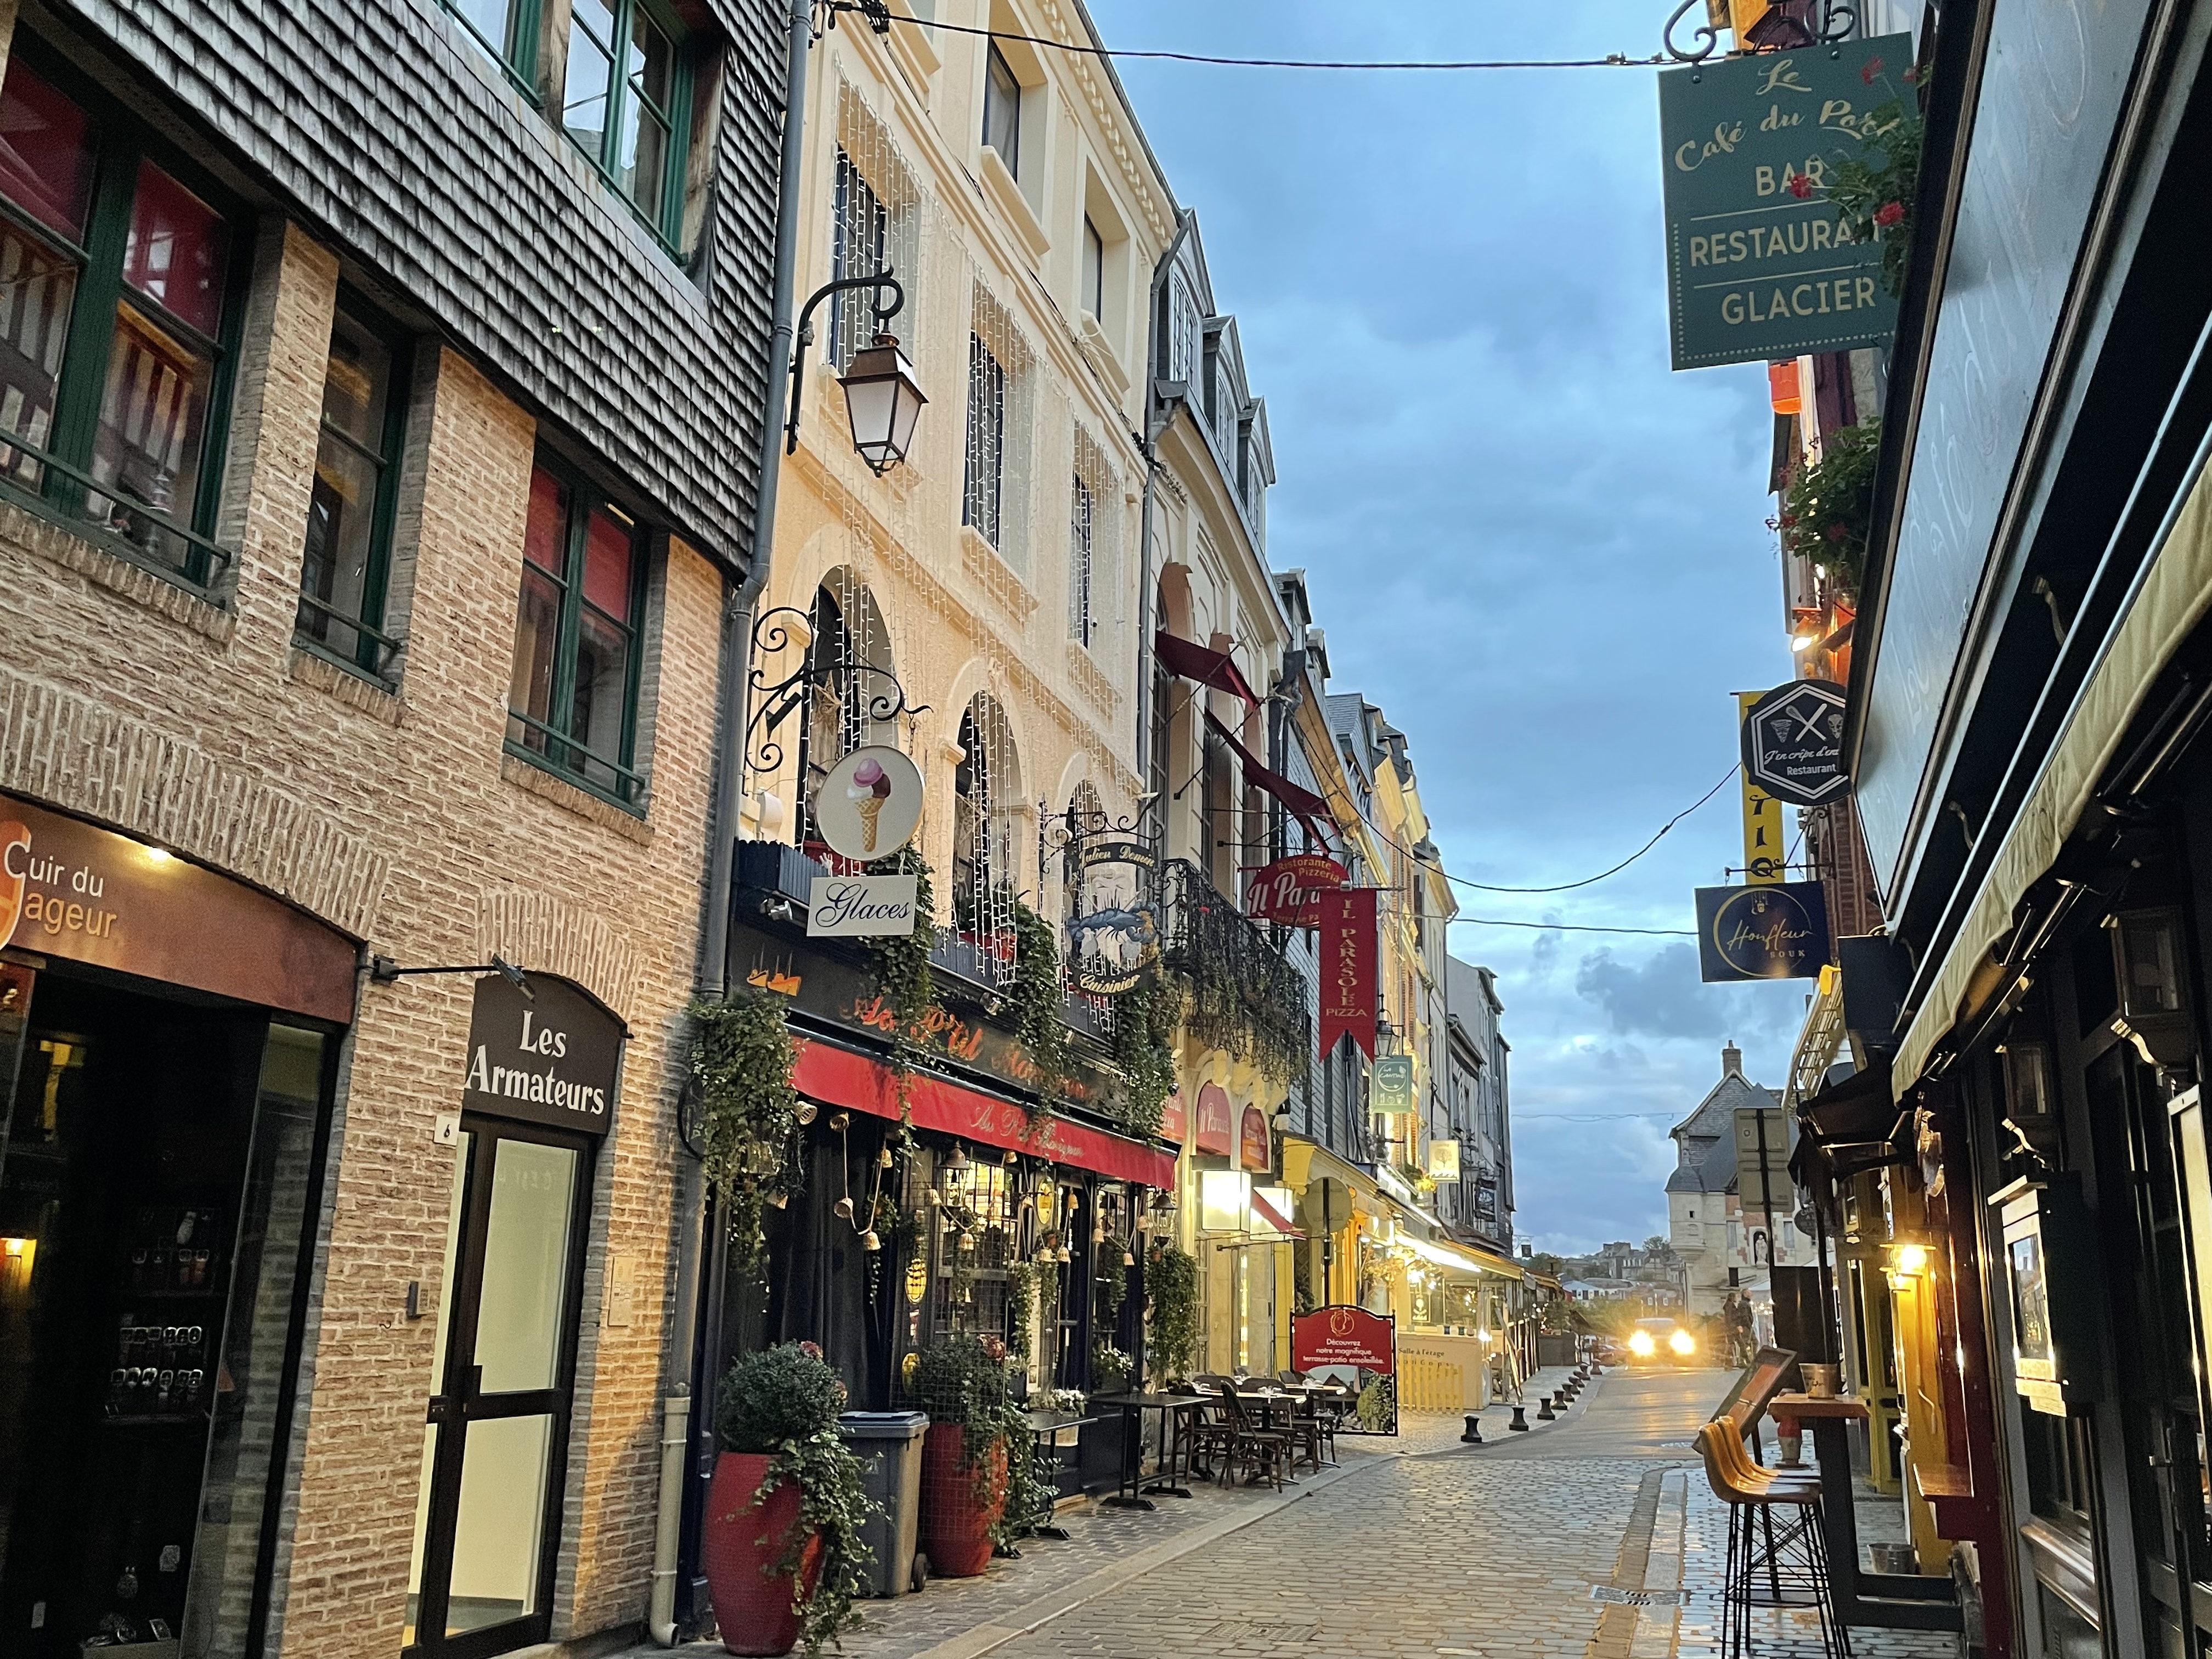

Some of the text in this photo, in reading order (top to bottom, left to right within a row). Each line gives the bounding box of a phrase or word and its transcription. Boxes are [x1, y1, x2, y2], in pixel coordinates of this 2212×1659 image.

[1756, 59, 1812, 95] Le
[1675, 121, 1747, 172] Café
[1760, 105, 1806, 132] du
[1755, 159, 1825, 196] BAR
[1721, 276, 1877, 325] GLACIER
[1786, 763, 1837, 776] Restaurant
[4, 840, 104, 898] Cuir du
[1277, 859, 1331, 872] Ristorante
[1299, 868, 1340, 883] Pizzeria
[815, 883, 911, 928] Glaces
[1249, 883, 1269, 913] Il
[1727, 918, 1814, 951] Honfleur
[1338, 928, 1358, 1006] PARASOLE
[1770, 950, 1805, 958] SOUK
[1080, 973, 1141, 992] Cuisinier
[1326, 1008, 1367, 1017] PIZZA
[520, 1010, 567, 1057] Les
[464, 1045, 604, 1115] Armateurs
[443, 1124, 450, 1138] 6
[1326, 1338, 1361, 1346] Découvrez
[1334, 1347, 1372, 1356] magnifique
[1303, 1356, 1347, 1364] terrasse-patio
